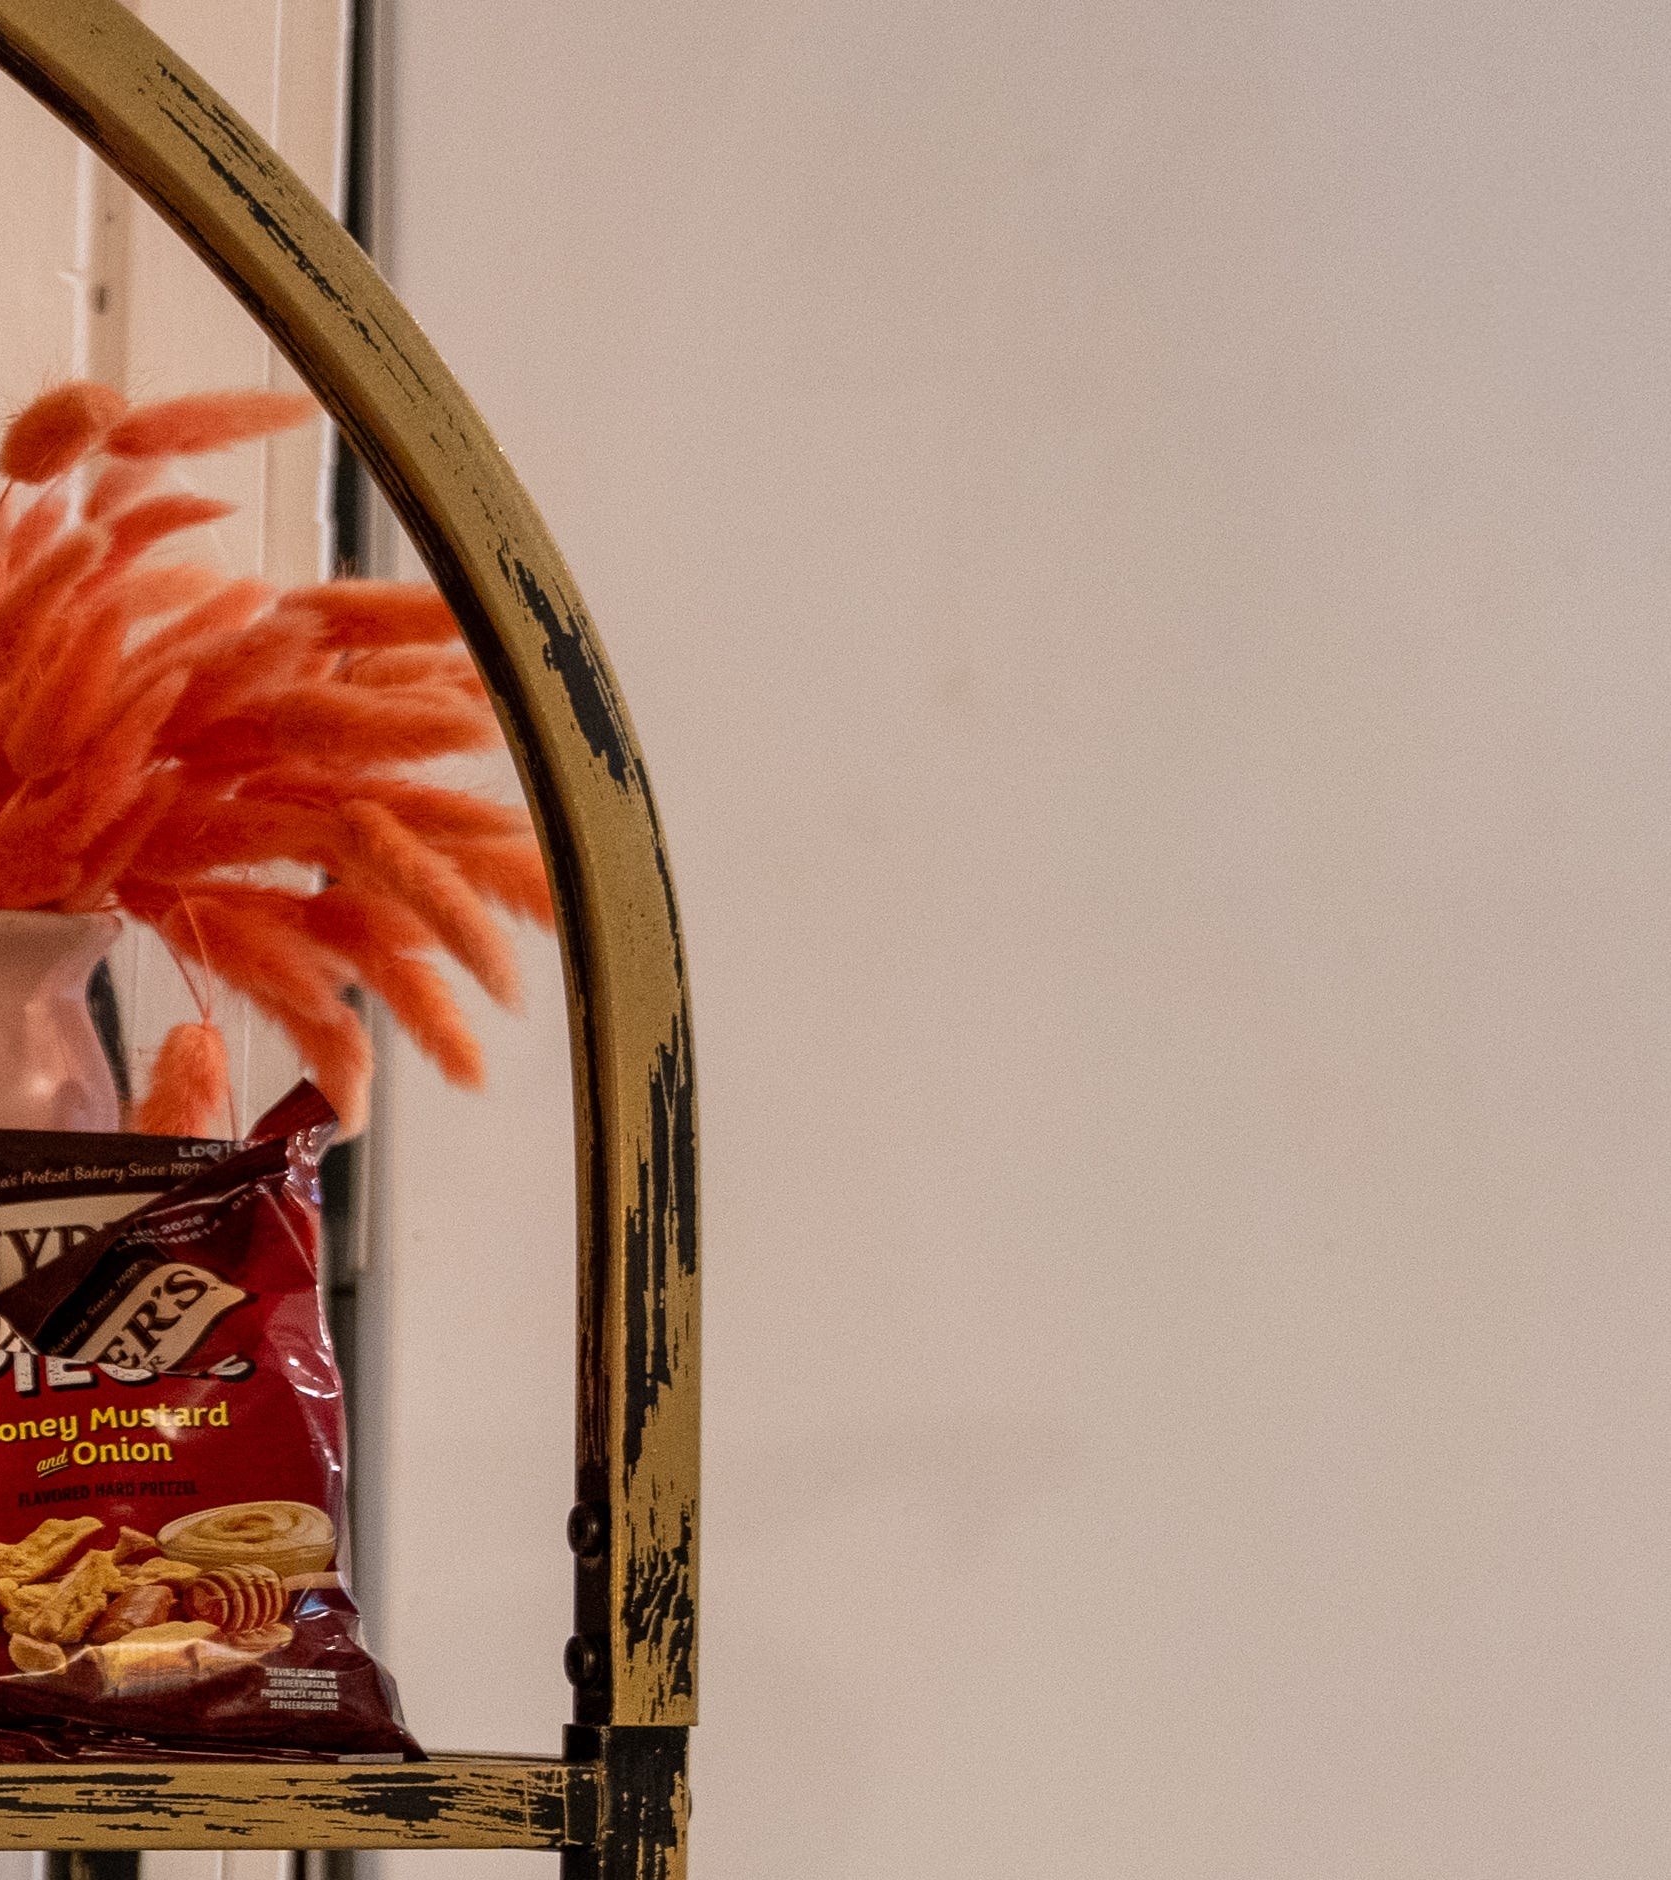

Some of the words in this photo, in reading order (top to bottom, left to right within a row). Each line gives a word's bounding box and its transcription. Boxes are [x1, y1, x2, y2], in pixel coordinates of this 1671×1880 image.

[23, 1165, 72, 1187] Pretzel
[74, 1163, 124, 1186] Bakery
[128, 1160, 167, 1178] Since
[90, 1402, 229, 1433] Mustard
[37, 1450, 68, 1473] and
[72, 1438, 173, 1467] Onion
[18, 1484, 90, 1508] FLAVORED
